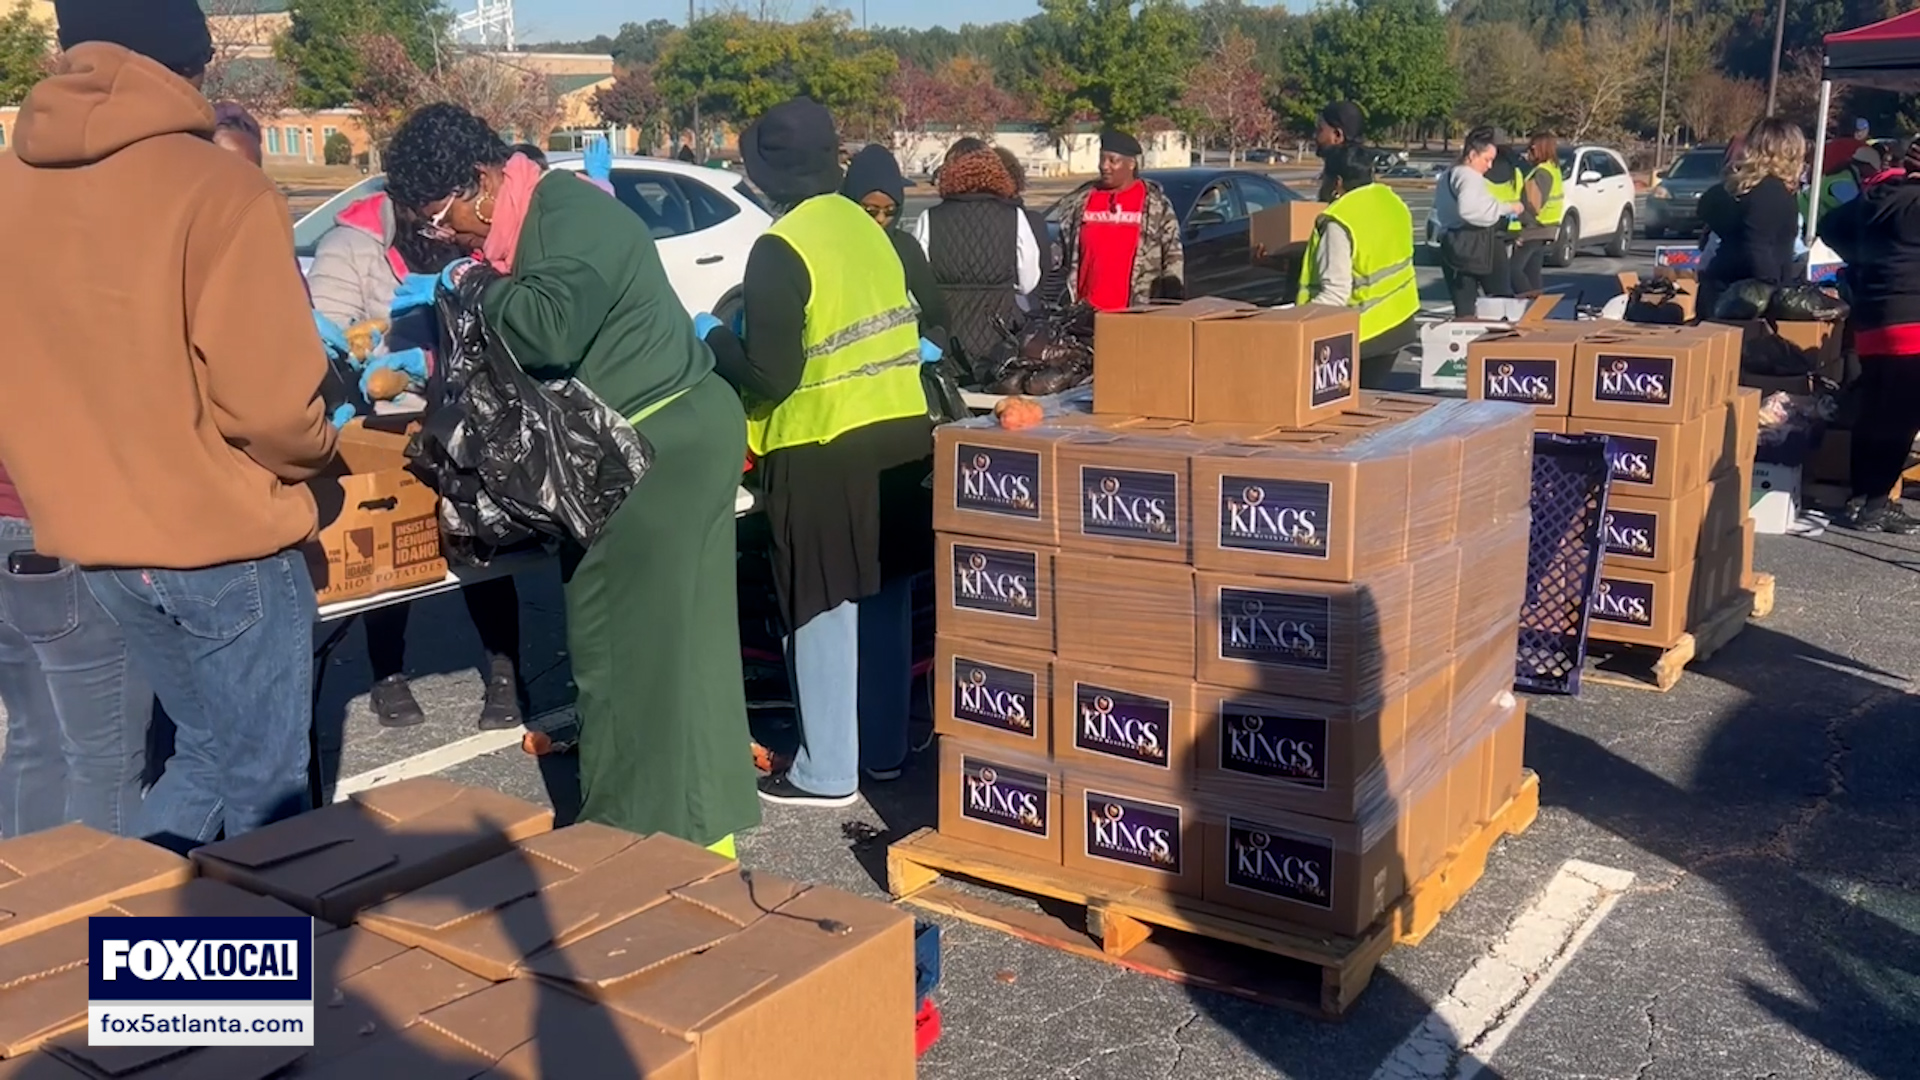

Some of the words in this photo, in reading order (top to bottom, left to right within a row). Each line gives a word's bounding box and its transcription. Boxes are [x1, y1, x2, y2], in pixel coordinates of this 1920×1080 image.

[1490, 363, 1549, 394] KINGS
[1602, 360, 1664, 393] KINGS
[965, 453, 1029, 500] KINGS
[1092, 477, 1164, 524] KINGS
[396, 520, 424, 537] INSIST
[1231, 486, 1315, 537] KINGS
[396, 528, 439, 549] GENUINE
[375, 562, 444, 582] POTATOES
[962, 553, 1027, 599] KINGS
[1231, 600, 1315, 649] KINGS
[962, 668, 1025, 717] KINGS
[1085, 695, 1158, 747] KINGS
[1232, 715, 1313, 768] KINGS
[971, 767, 1038, 818] KINGS
[1096, 803, 1169, 854] KINGS
[1239, 832, 1319, 887] KINGS
